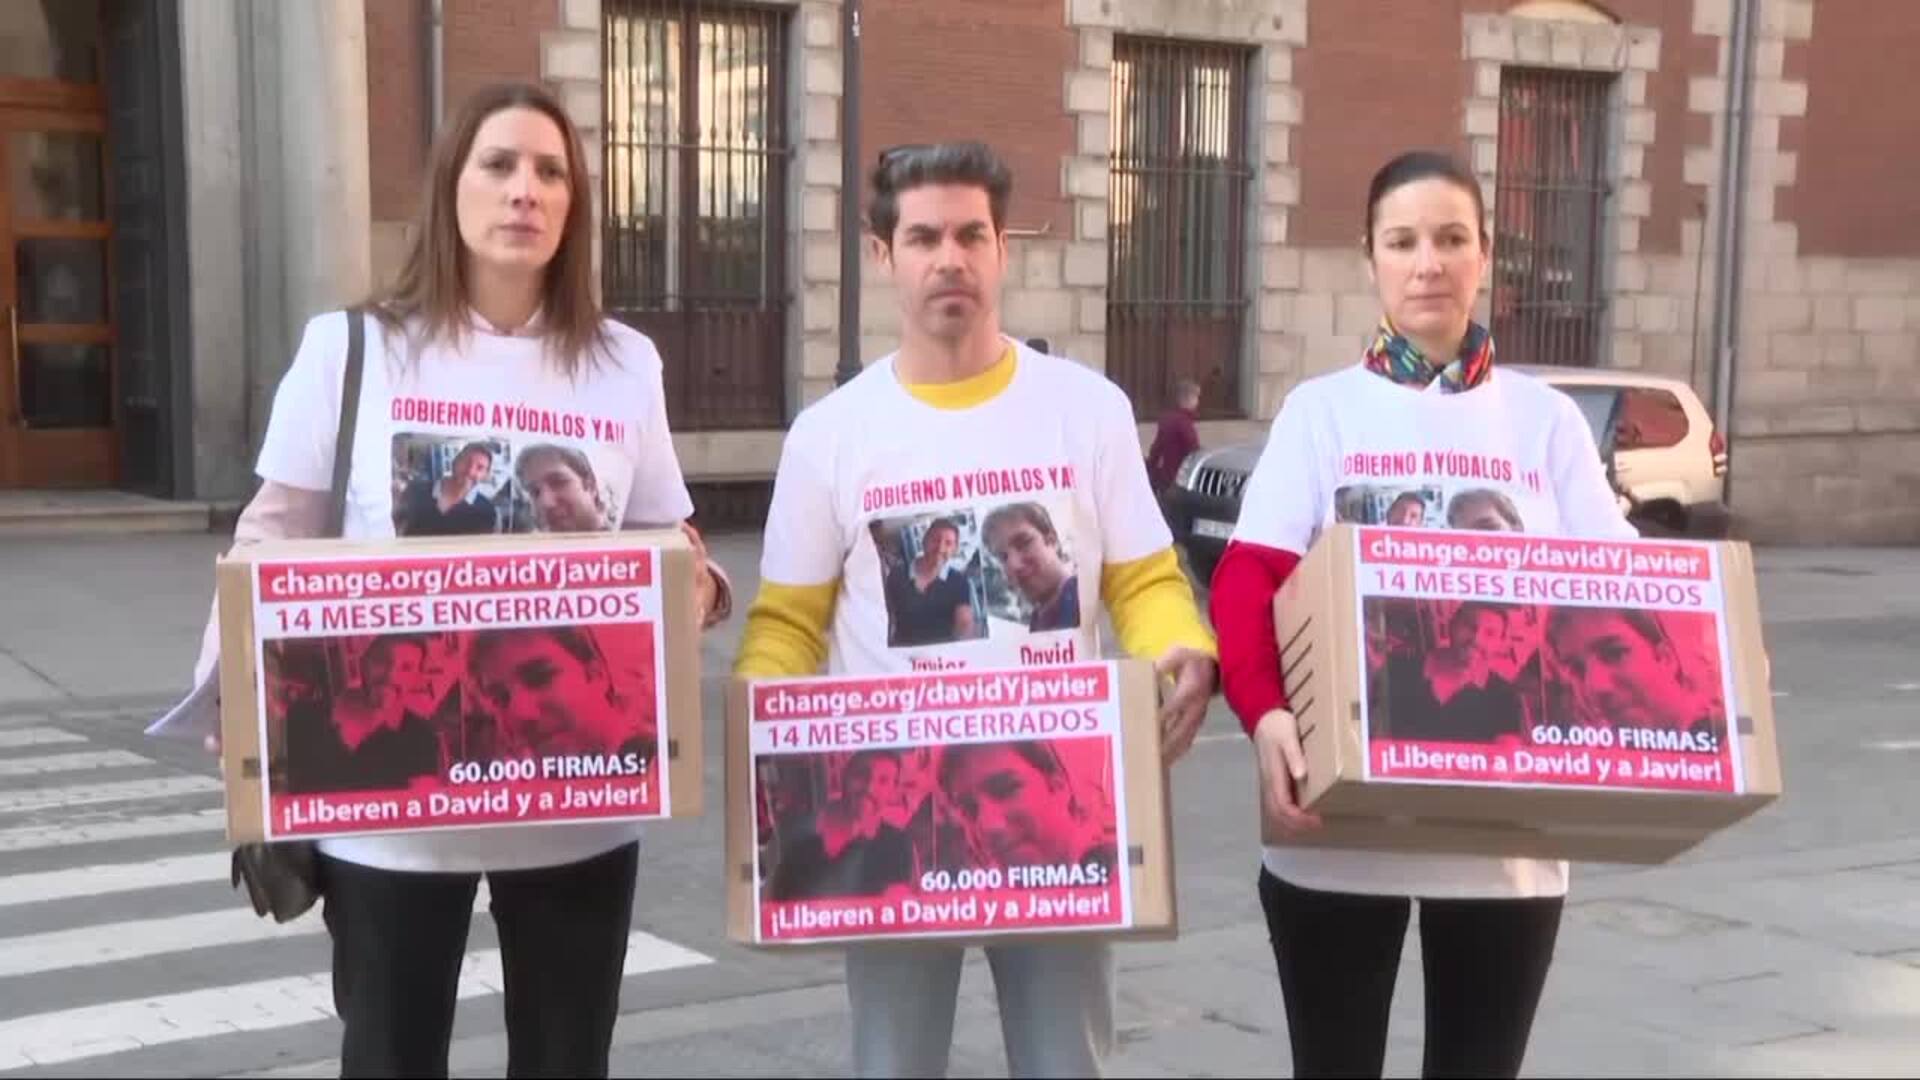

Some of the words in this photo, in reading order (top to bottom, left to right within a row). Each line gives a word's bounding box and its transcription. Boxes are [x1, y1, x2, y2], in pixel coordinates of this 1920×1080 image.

[391, 397, 485, 426] GOBIERNO
[491, 400, 585, 438] AYÚDALOS
[1344, 451, 1417, 477] OBIERNO
[1423, 448, 1512, 482] AYÚDALOS
[863, 476, 946, 512] GOBIERNO
[952, 468, 1045, 499] AYÚDALOS
[1375, 569, 1406, 591] 14
[1415, 572, 1505, 597] MESES
[1514, 576, 1702, 606] ENCERRADOS
[276, 608, 312, 632] 14
[322, 602, 424, 630] MESES
[433, 592, 640, 625] ENCERRADOS
[768, 726, 800, 748] 14
[808, 720, 899, 746] MESES
[907, 708, 1099, 740] ENCERRADOS
[1531, 725, 1613, 747] 60.000
[1619, 728, 1719, 753] FIRMAS:
[449, 759, 536, 784] 60.000
[543, 753, 647, 778] FIRMAS:
[1382, 745, 1487, 773] ¡Liberen
[1493, 755, 1507, 771] a
[1514, 750, 1590, 776] David
[1596, 758, 1611, 782] y
[1617, 760, 1632, 777] a
[1639, 759, 1722, 781] Javier!
[284, 798, 399, 830] ¡Liberen
[406, 801, 422, 817] a
[430, 789, 508, 816] David
[516, 794, 531, 818] y
[539, 792, 554, 809] a
[560, 782, 648, 809] Javier!
[921, 870, 1001, 891] 60.000
[1008, 864, 1108, 888] FIRMAS:
[772, 904, 874, 936] ¡Liberen
[881, 908, 895, 924] a
[902, 896, 976, 924] David
[984, 901, 998, 925] y
[1004, 901, 1018, 917] a
[1025, 892, 1109, 917] Javier!
